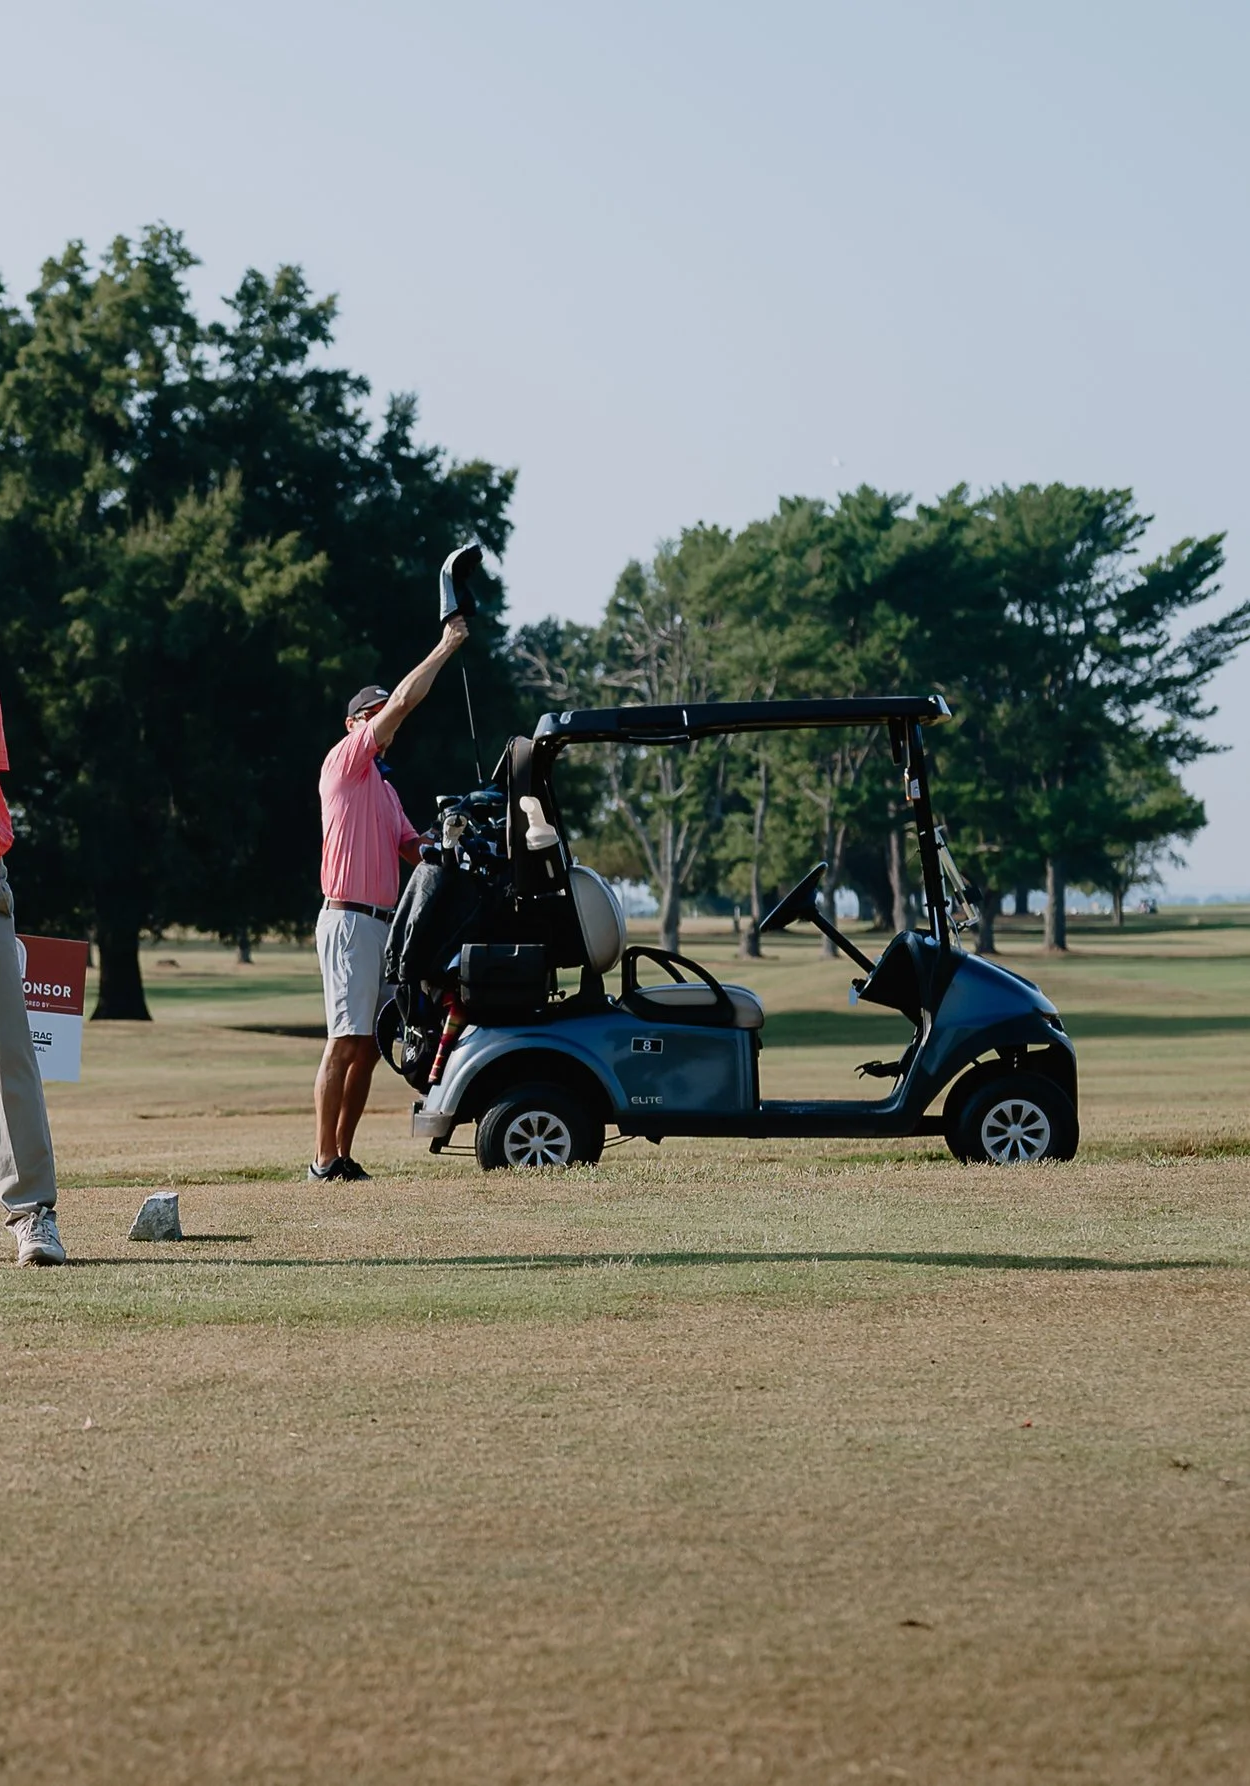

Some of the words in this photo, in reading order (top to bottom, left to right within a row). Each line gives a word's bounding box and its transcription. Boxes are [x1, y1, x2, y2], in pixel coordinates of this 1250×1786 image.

[22, 981, 71, 998] ONSOR
[643, 1040, 652, 1051] 8
[631, 1096, 663, 1104] ELITE
